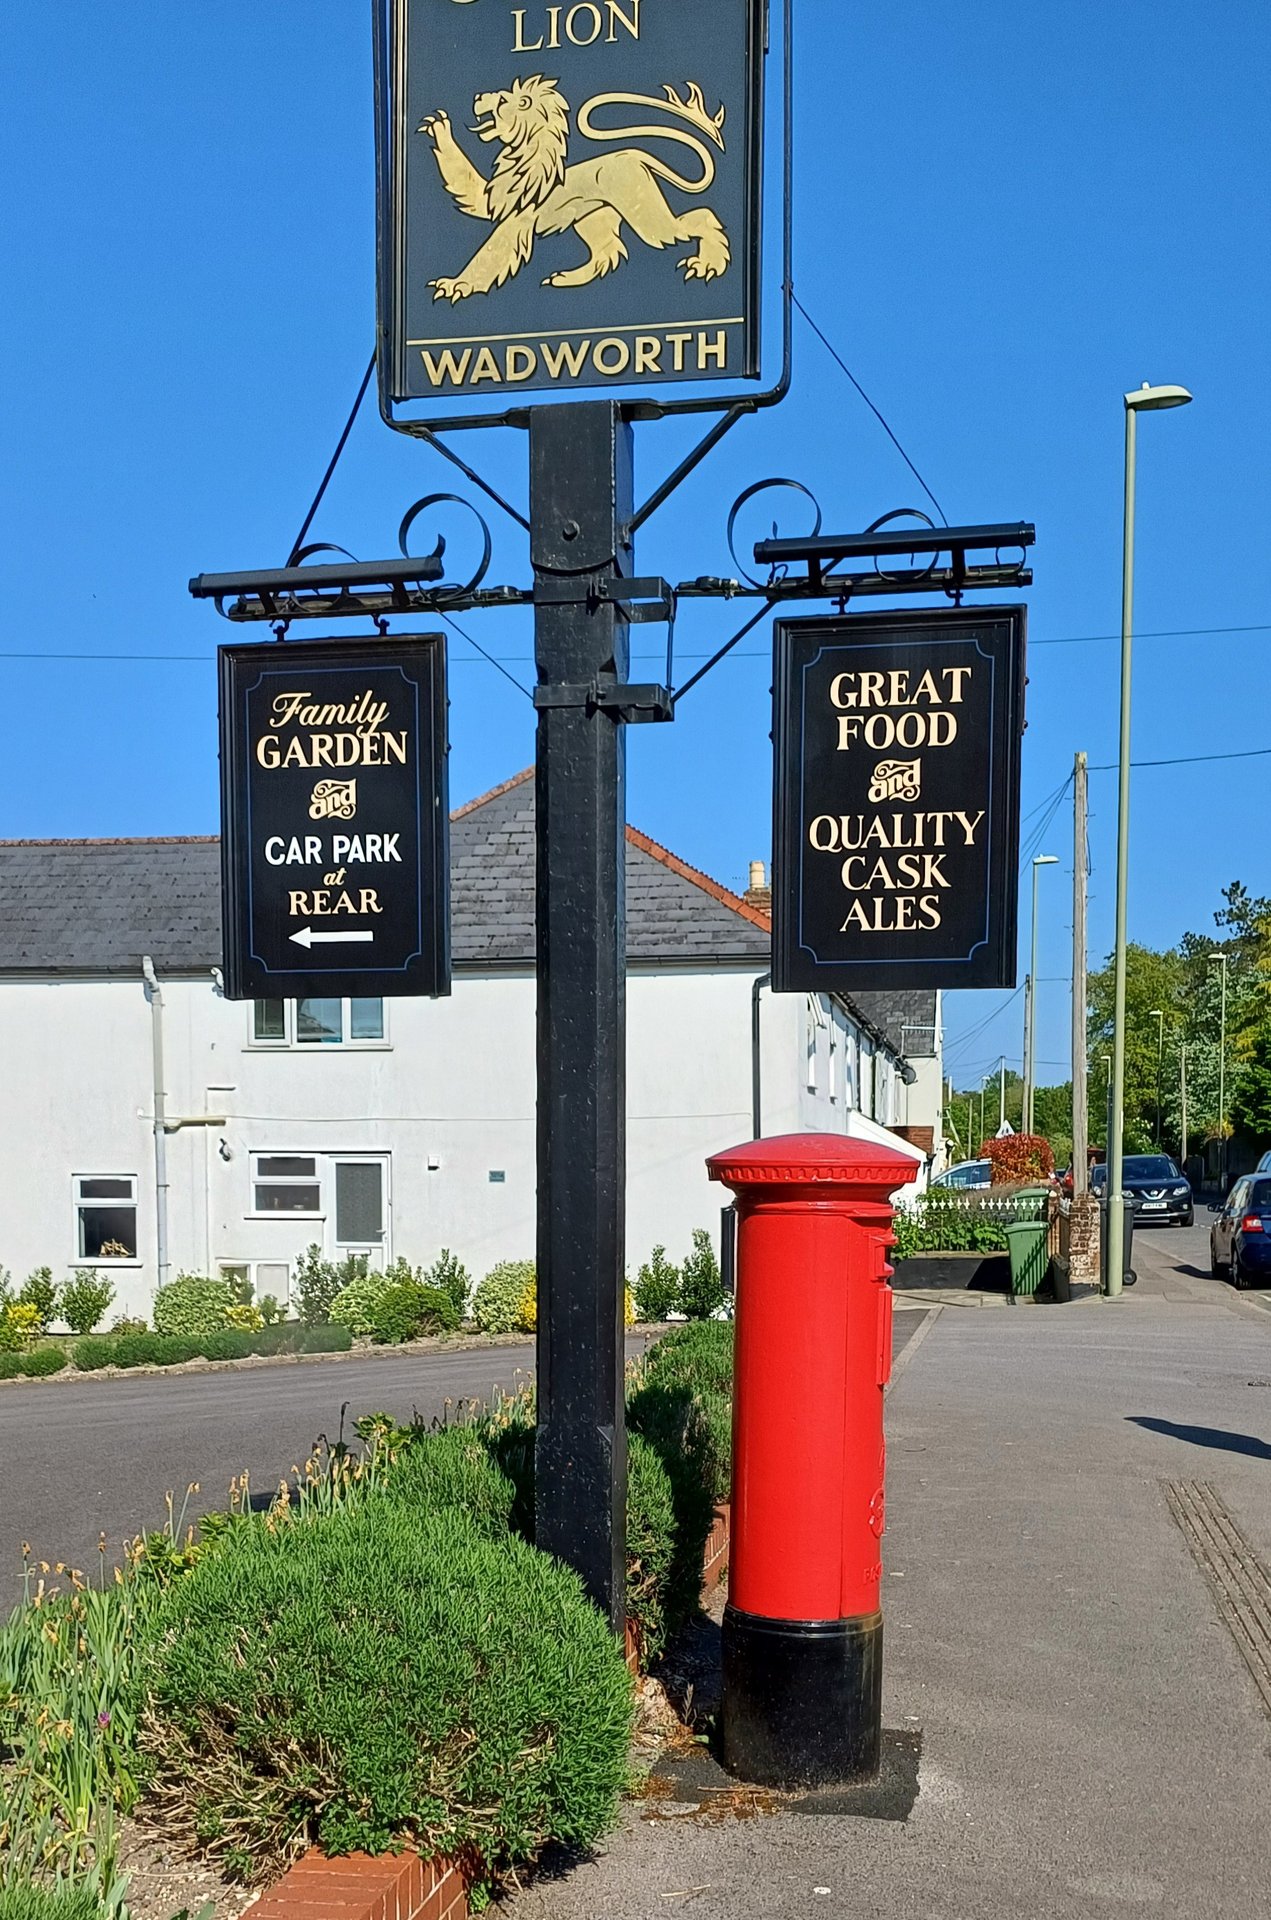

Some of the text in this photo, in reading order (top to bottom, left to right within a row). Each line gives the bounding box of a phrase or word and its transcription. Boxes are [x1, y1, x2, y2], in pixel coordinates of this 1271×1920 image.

[510, 0, 640, 52] LION
[420, 330, 726, 386] WADWORTH
[830, 667, 972, 709] GREAT
[269, 689, 390, 738] Family
[836, 711, 957, 751] FOOD
[256, 731, 408, 769] GARDEN
[308, 778, 357, 820] and
[867, 757, 922, 803] and
[264, 833, 403, 866] CAR PARK
[809, 810, 986, 853] QUALITY
[323, 867, 347, 887] at
[841, 853, 952, 891] CASK
[288, 888, 384, 916] REAR
[839, 894, 941, 932] ALES
